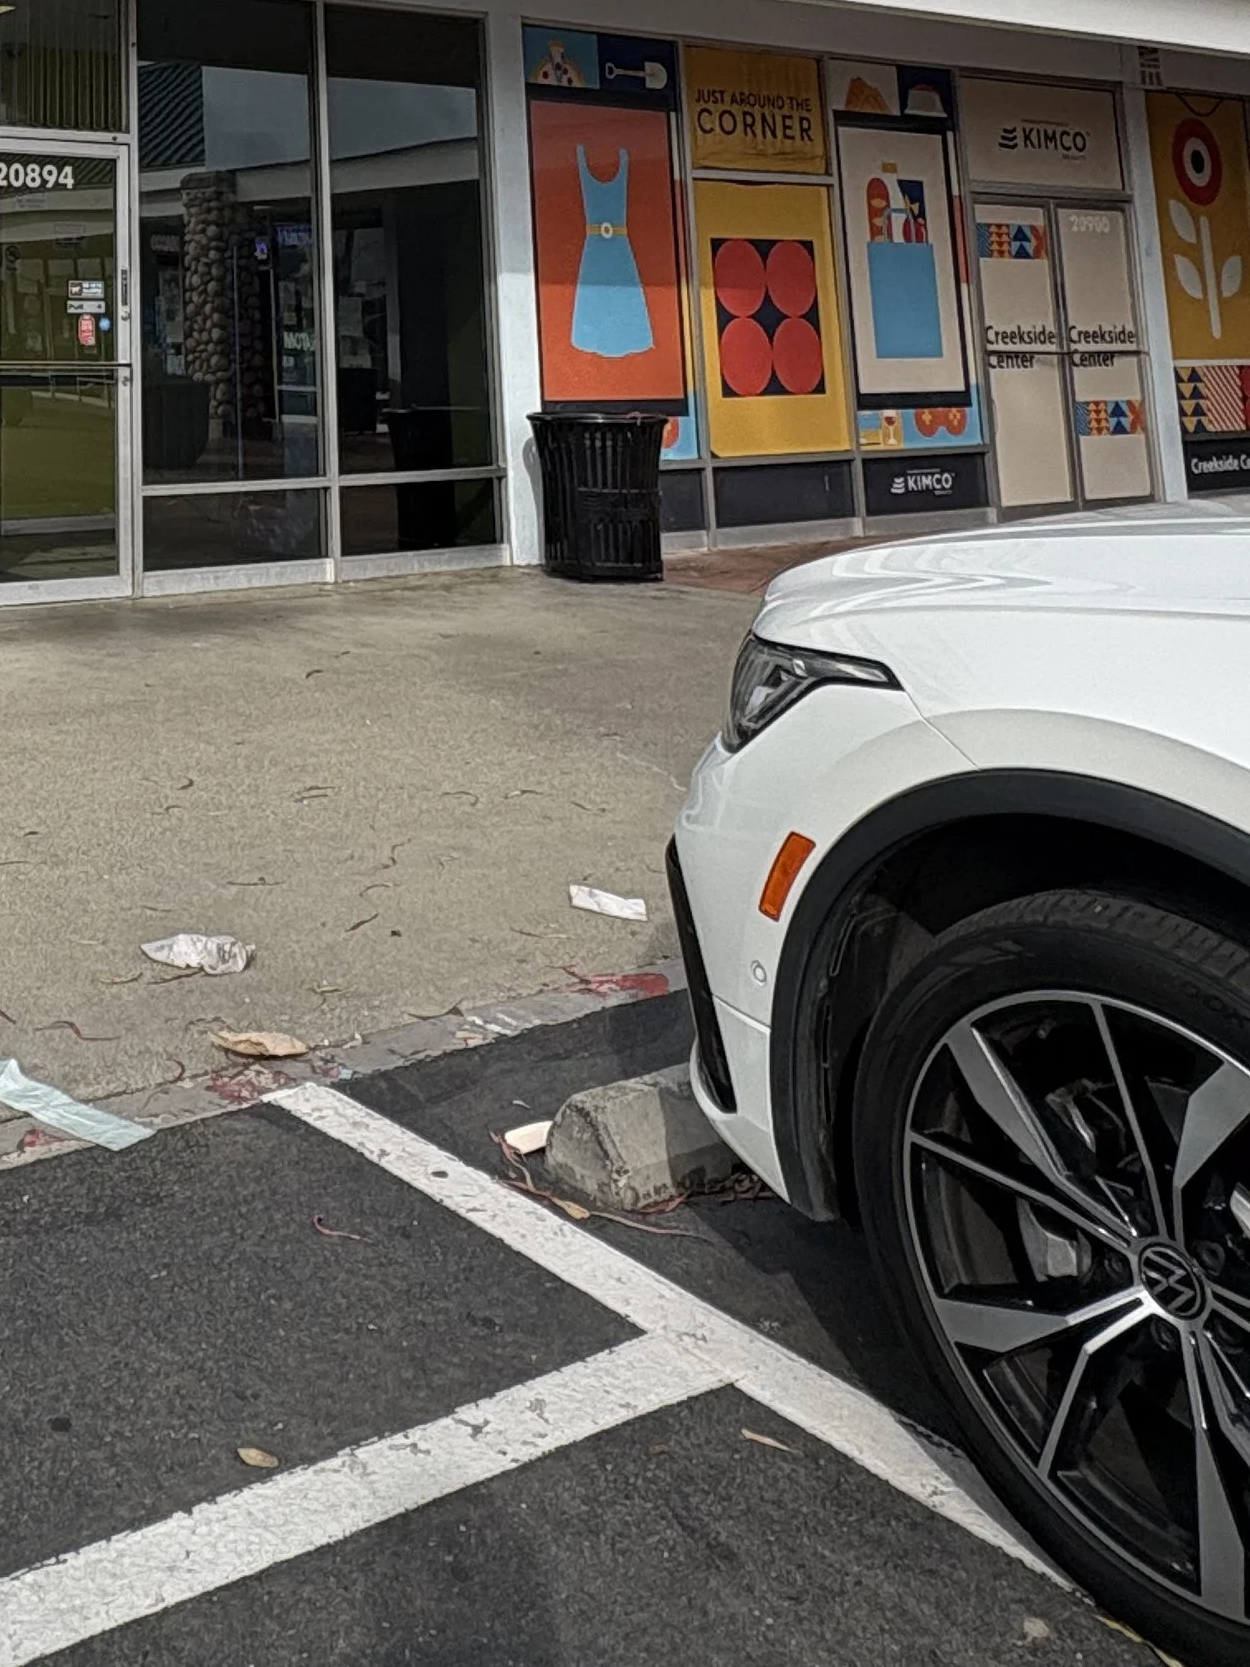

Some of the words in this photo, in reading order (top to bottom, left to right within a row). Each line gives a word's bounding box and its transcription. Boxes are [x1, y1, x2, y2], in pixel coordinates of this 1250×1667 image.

[695, 89, 726, 104] JUST
[730, 92, 785, 110] AROUND
[788, 96, 812, 112] THE
[697, 107, 814, 142] CORNER
[1022, 126, 1087, 152] KIMCO
[1070, 215, 1111, 233] 20900
[985, 324, 1056, 345] Creekside
[1069, 324, 1136, 345] Creekside
[987, 351, 1035, 369] Center
[1070, 348, 1116, 367] Center
[1191, 454, 1240, 474] Creekside
[907, 473, 952, 491] KIMCO
